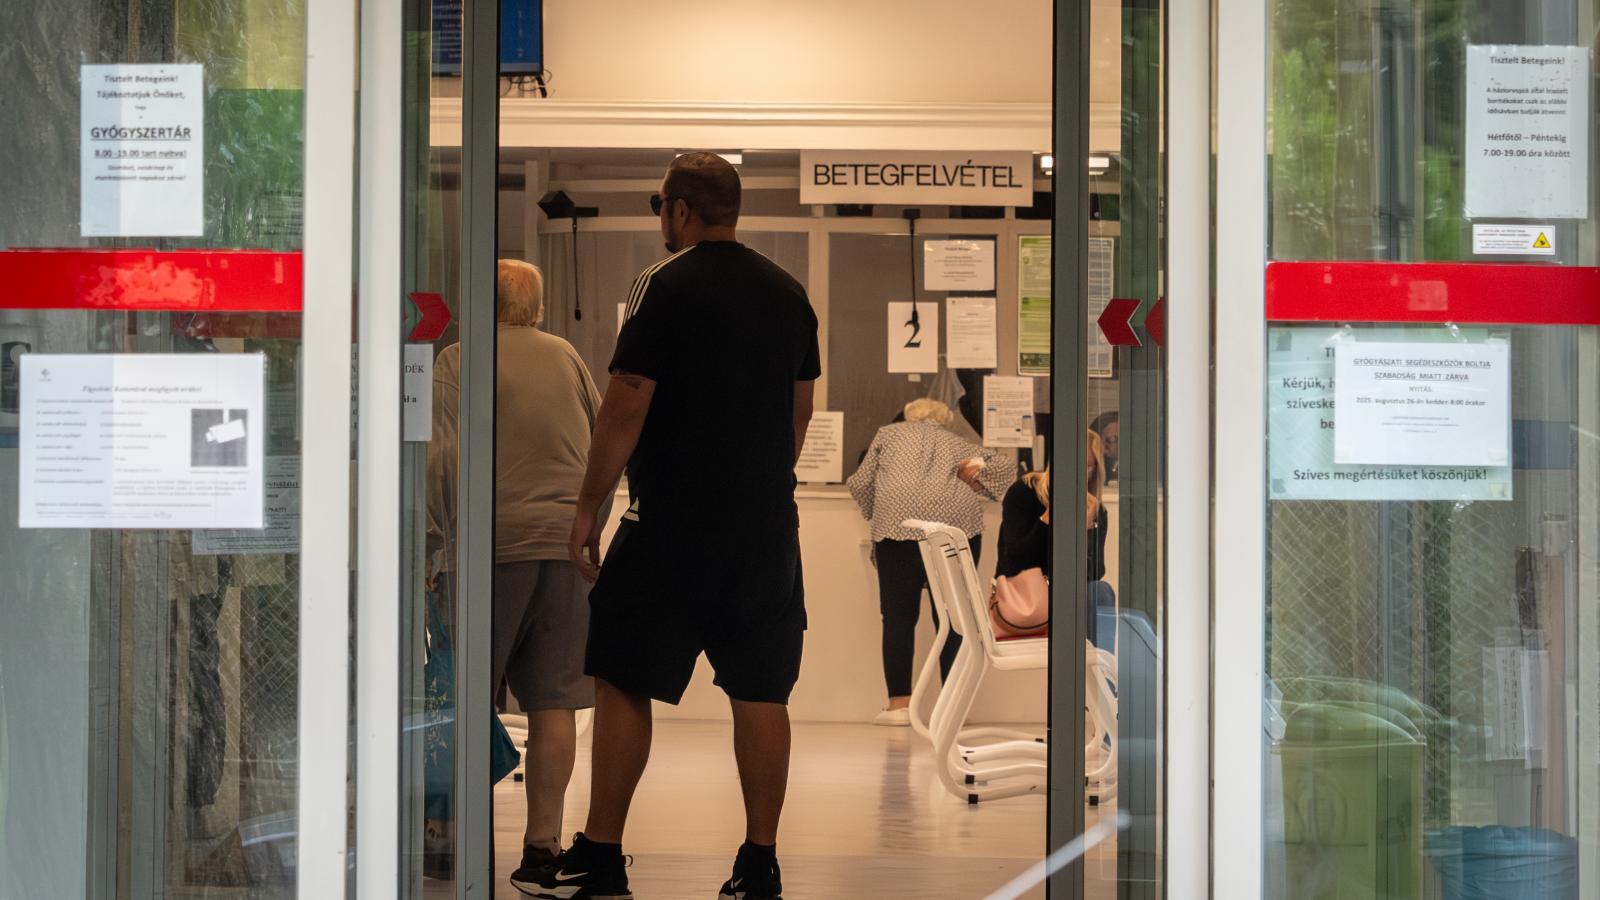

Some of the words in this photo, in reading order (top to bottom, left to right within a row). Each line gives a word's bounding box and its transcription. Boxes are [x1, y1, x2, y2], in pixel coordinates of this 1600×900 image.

[1489, 56, 1519, 64] Tisztelt
[1521, 57, 1565, 66] Betegeink!
[135, 75, 178, 84] Betegeink!
[90, 124, 191, 139] GYÓGYSZERTÁR
[1530, 134, 1567, 143] Péntekig
[814, 160, 1023, 189] BETEGFELVÉTEL
[904, 319, 921, 349] 2
[1282, 377, 1325, 390] Kérjük,
[1419, 373, 1442, 381] MIATT
[1293, 468, 1331, 480] Szíves
[1333, 468, 1418, 483] megértésüket
[1420, 467, 1487, 483] köszönjük!
